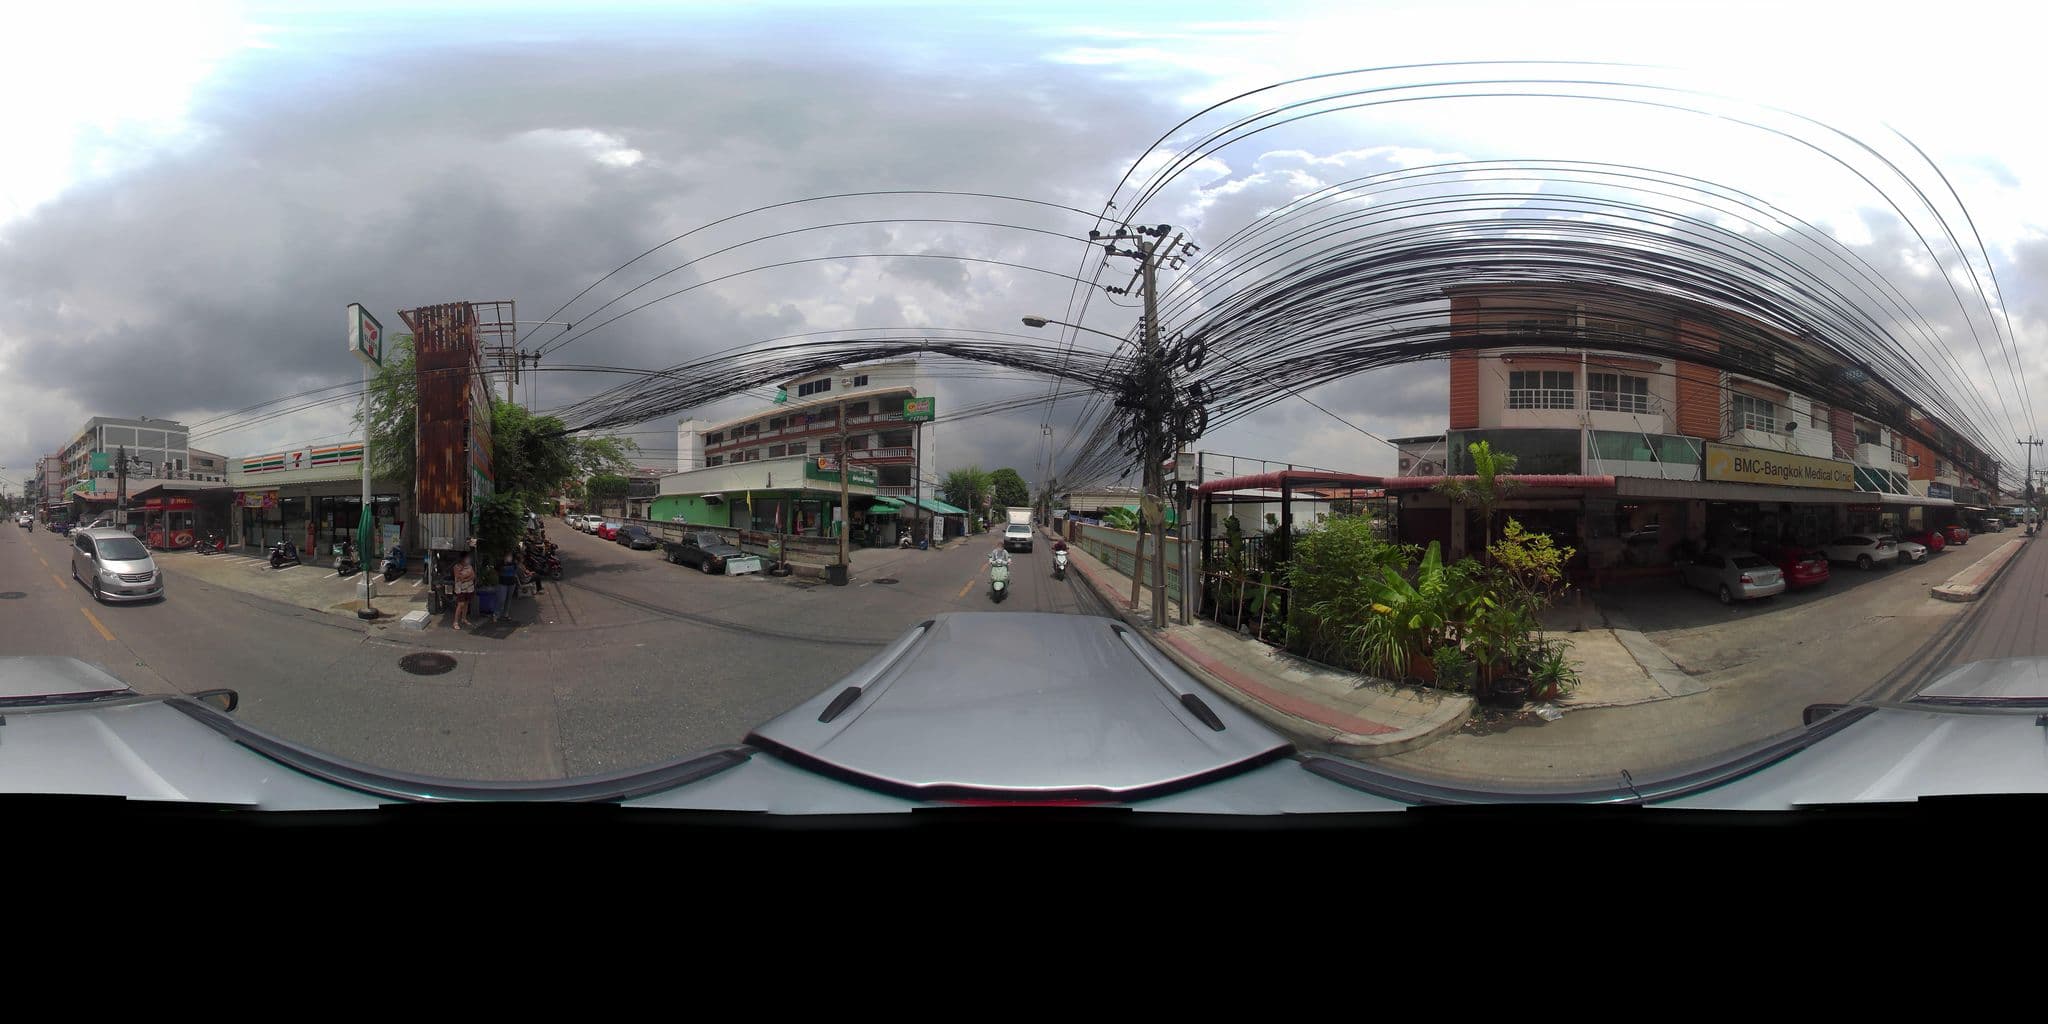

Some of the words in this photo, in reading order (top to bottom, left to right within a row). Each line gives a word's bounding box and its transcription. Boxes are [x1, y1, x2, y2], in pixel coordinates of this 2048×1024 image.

[292, 452, 303, 468] 7
[1734, 457, 1803, 480] BMC-Bangkok
[1805, 466, 1833, 481] Medical
